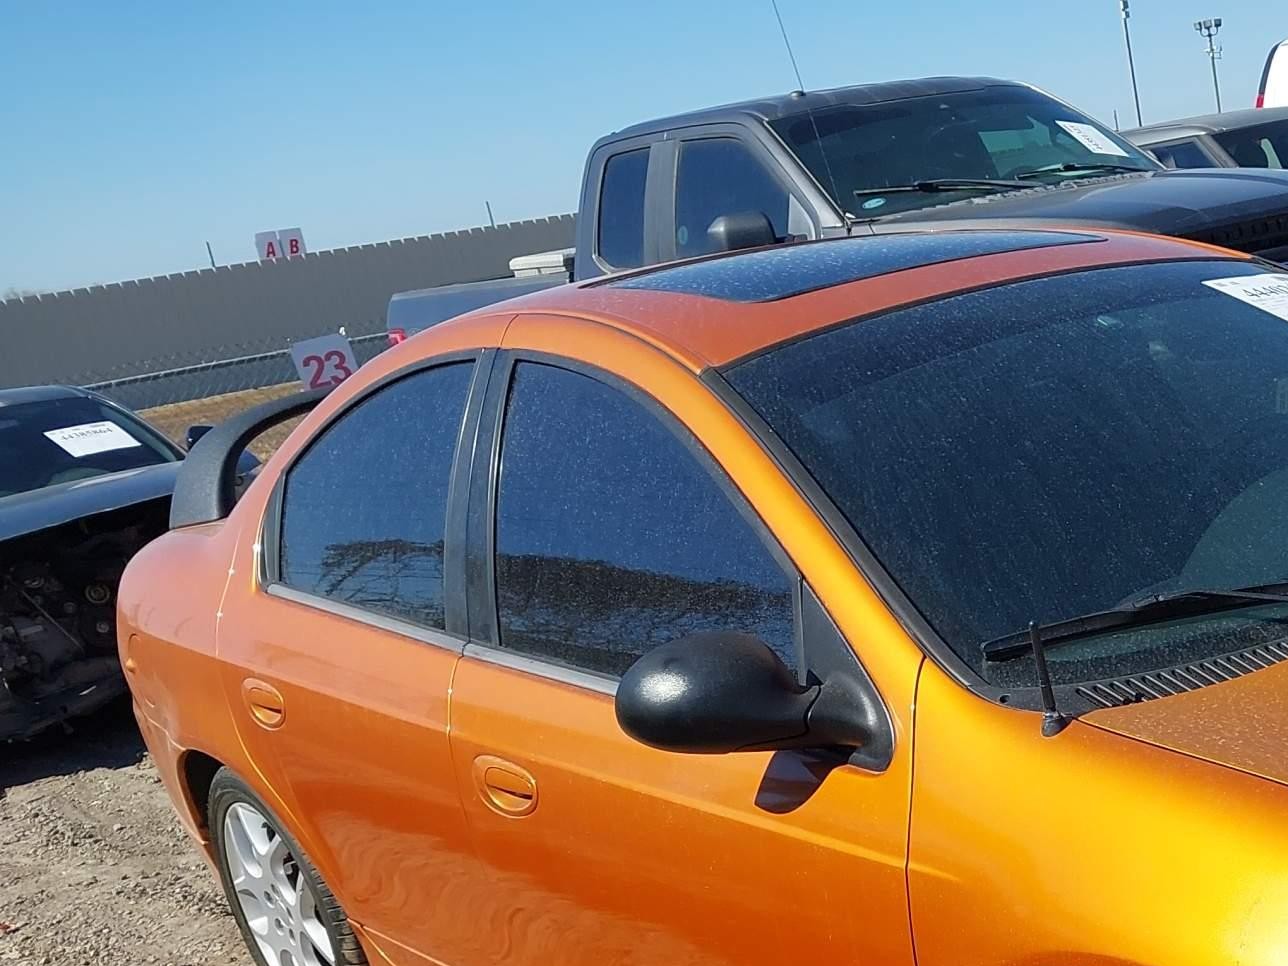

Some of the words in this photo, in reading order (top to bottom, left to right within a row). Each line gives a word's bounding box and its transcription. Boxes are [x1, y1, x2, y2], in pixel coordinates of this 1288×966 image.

[266, 241, 276, 257] A
[289, 239, 299, 254] B
[303, 350, 352, 389] 23
